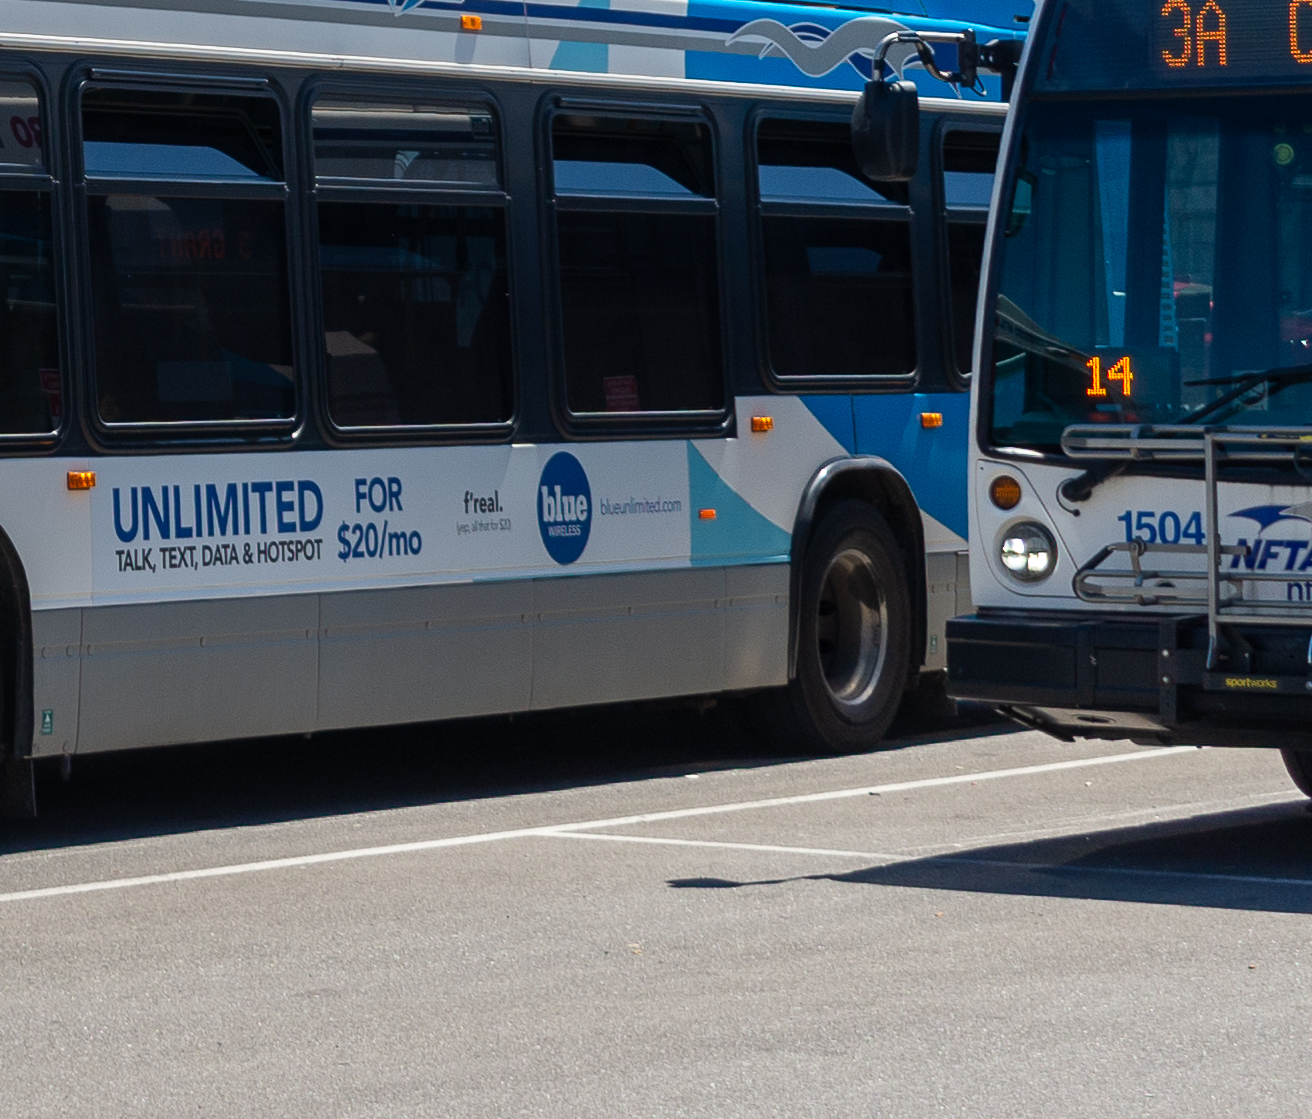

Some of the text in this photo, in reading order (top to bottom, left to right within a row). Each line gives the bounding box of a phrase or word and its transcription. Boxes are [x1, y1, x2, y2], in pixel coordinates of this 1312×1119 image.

[1086, 356, 1134, 396] 14
[112, 480, 324, 543] UNLIMITED
[354, 477, 404, 513] FOR
[463, 490, 504, 514] f'real.
[540, 485, 588, 523] blue
[600, 497, 682, 516] blueunlimited.com
[337, 520, 422, 563] $20/mo
[548, 524, 582, 537] WIRELESS
[1118, 510, 1206, 546] 1504
[115, 539, 323, 573] TALK, TEXT, DATA & HOTSPOT
